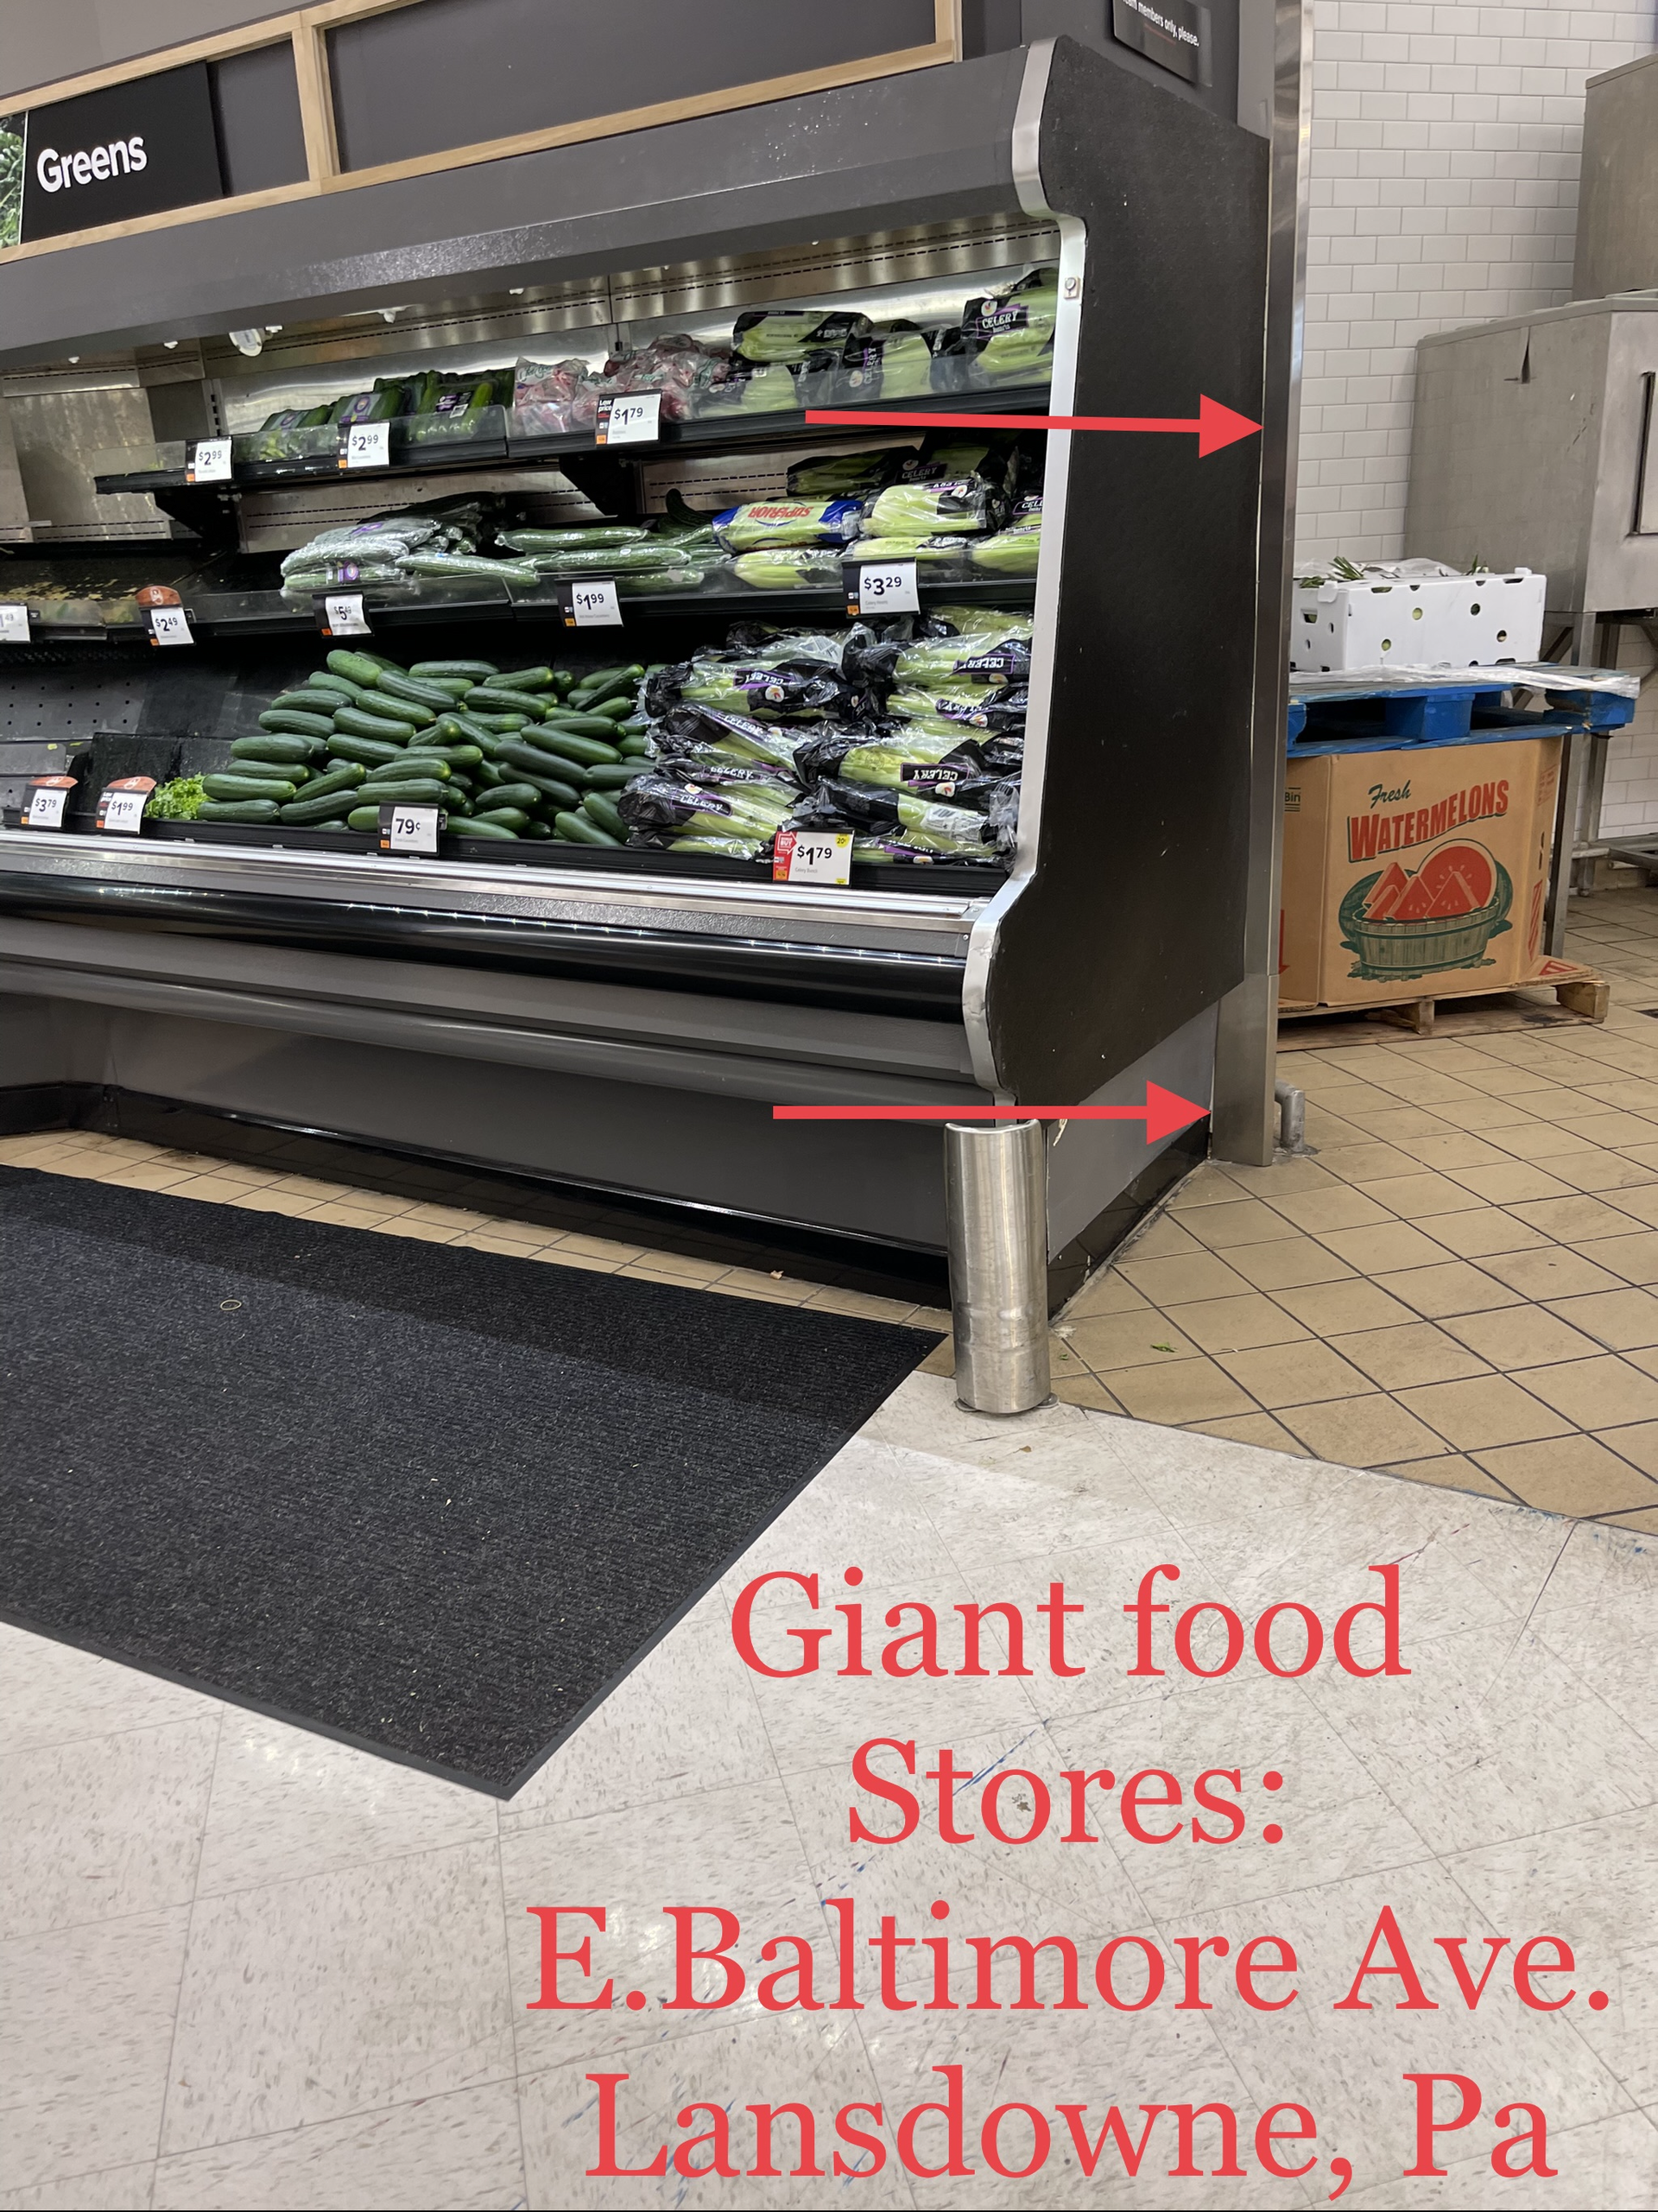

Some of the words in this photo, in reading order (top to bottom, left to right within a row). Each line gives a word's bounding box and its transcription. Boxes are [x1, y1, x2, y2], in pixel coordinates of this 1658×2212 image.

[1138, 2, 1163, 27] members
[1178, 26, 1199, 47] please.
[37, 136, 147, 193] Greens
[982, 310, 1018, 329] CELERY
[902, 466, 937, 479] CELERY
[748, 506, 814, 518] SUPERIOR
[744, 671, 784, 685] CELERY
[913, 770, 959, 781] CELERY
[1368, 780, 1412, 809] Fresh
[1347, 779, 1509, 863] WATERMELONS
